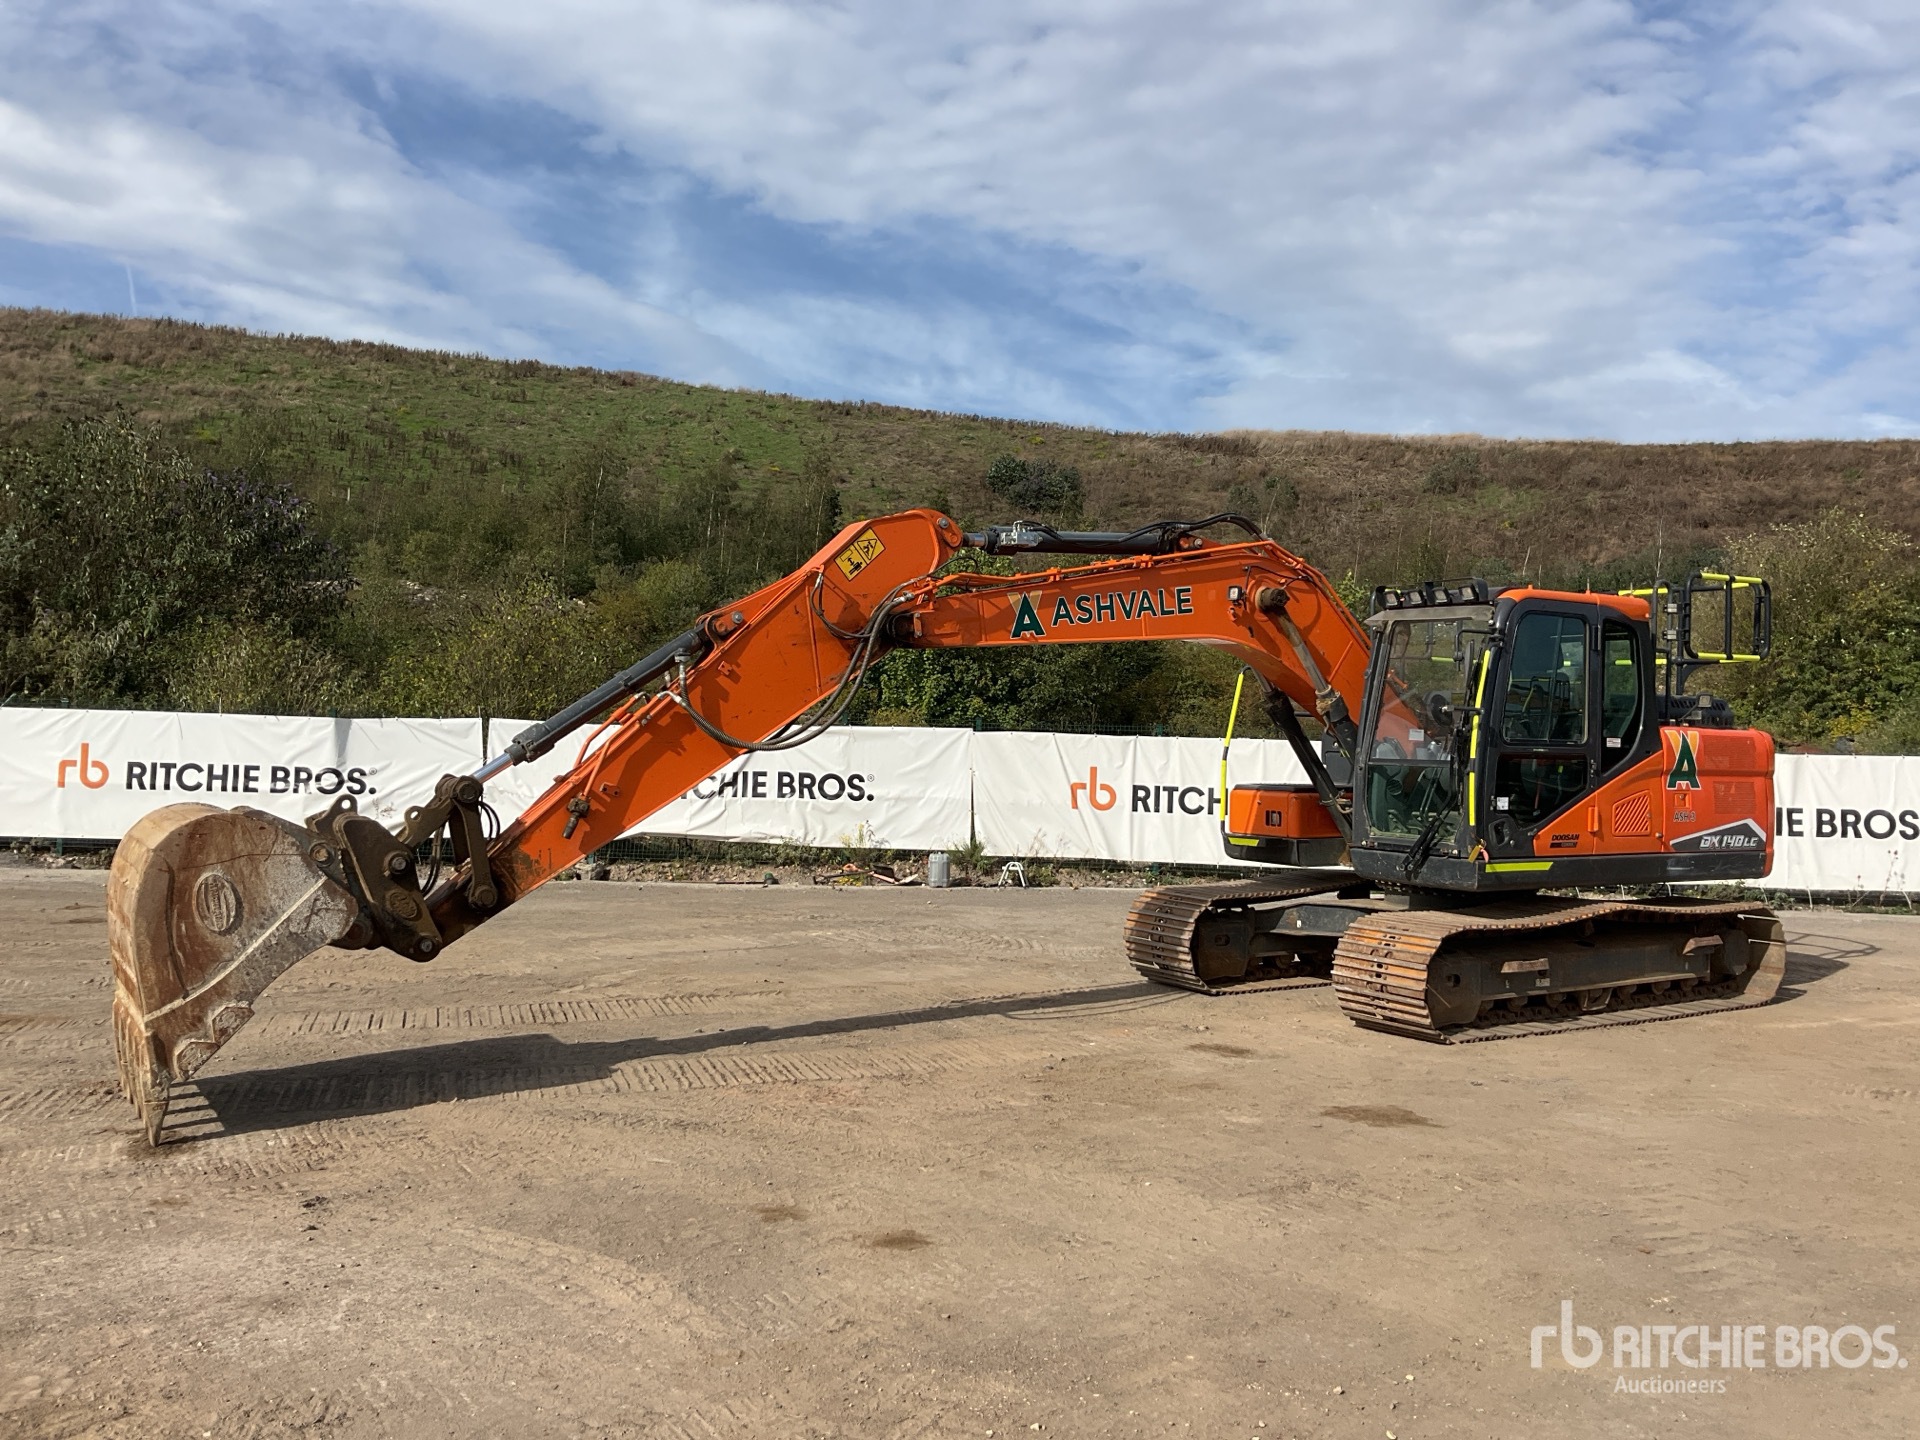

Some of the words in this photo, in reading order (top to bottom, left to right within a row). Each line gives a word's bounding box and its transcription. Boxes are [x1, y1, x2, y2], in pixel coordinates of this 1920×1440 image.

[1051, 586, 1194, 627] ASHVALE
[126, 761, 260, 793] RITCHIE
[269, 766, 377, 795] BROS.
[680, 770, 768, 800] CHIE
[777, 771, 875, 802] BROS.
[1551, 833, 1580, 841] DOOSAN
[1815, 807, 1920, 841] BROS
